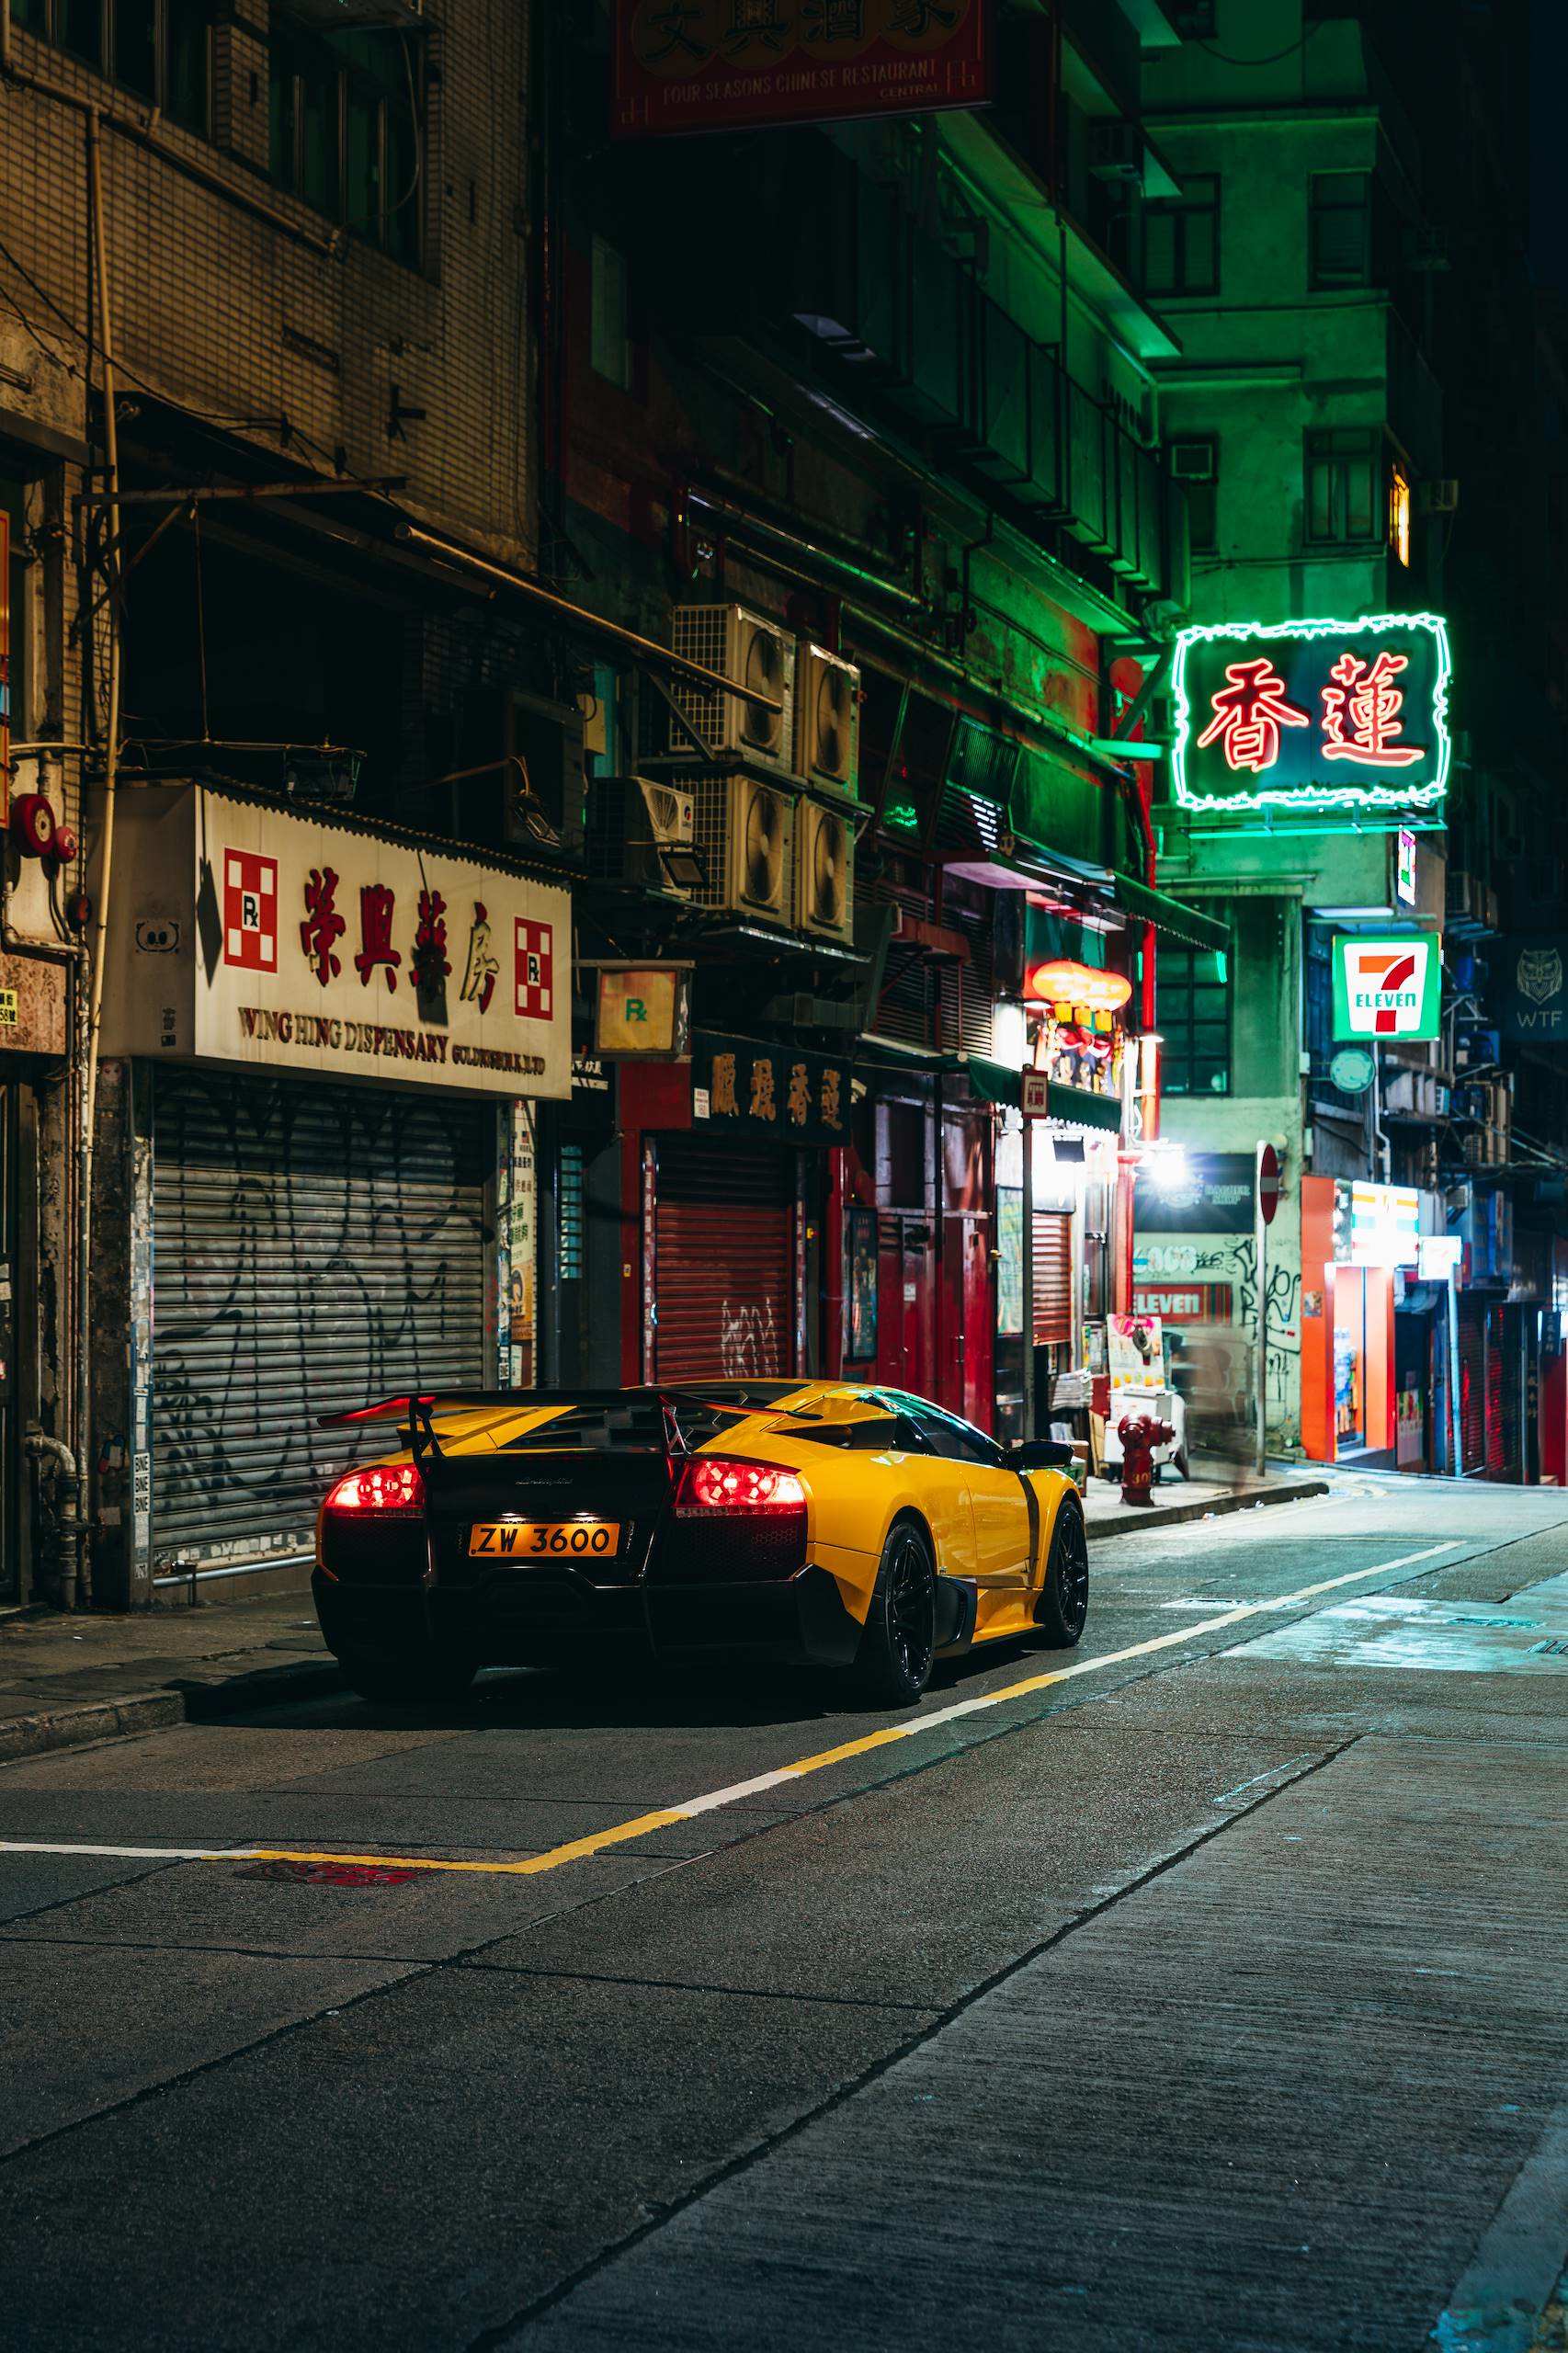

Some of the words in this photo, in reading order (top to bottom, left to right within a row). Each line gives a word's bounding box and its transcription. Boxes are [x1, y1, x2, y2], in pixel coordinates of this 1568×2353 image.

[663, 82, 702, 106] FOUR
[705, 75, 772, 102] SEASONS
[776, 68, 837, 95] CHINESE
[842, 59, 937, 88] RESTAURANT
[880, 84, 941, 100] CENTRAL
[1517, 1011, 1562, 1028] WTF
[237, 1006, 293, 1044] WING
[294, 1014, 343, 1050] HING
[344, 1021, 449, 1064] DISPENSARY
[476, 1528, 518, 1553] ZW
[529, 1528, 610, 1553] 3600
